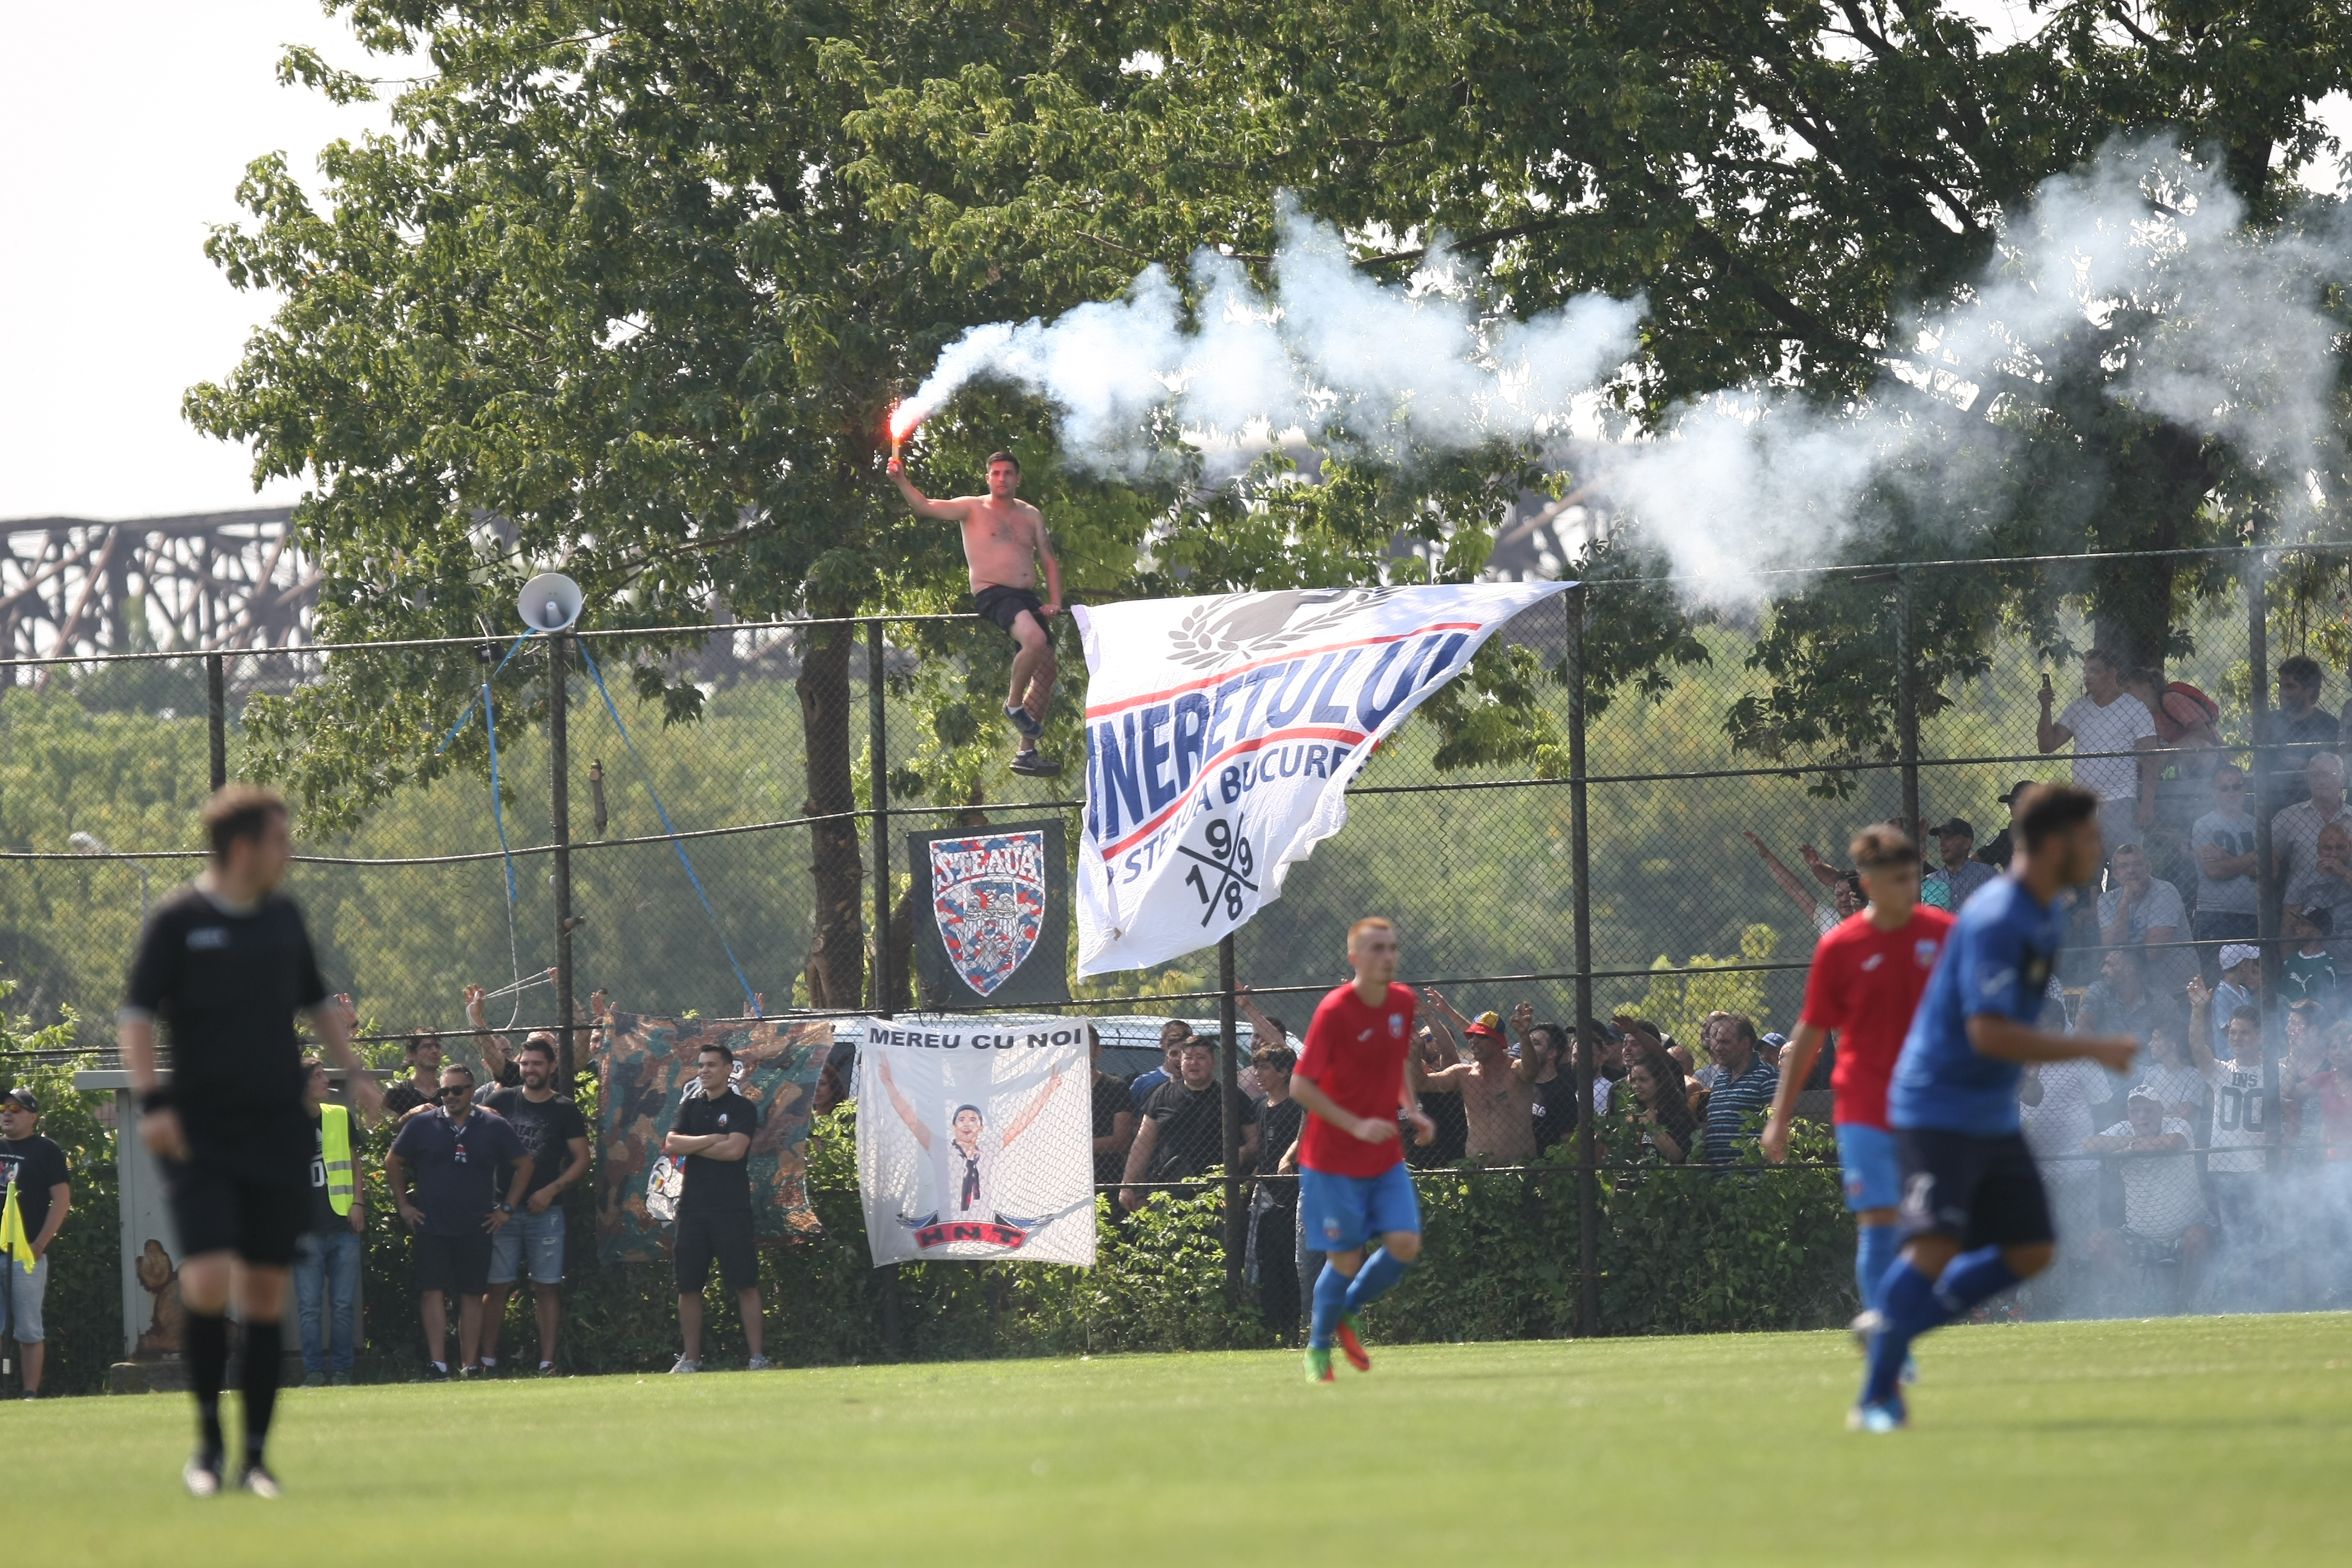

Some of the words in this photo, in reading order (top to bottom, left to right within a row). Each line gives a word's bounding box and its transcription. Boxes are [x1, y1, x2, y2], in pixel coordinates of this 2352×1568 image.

[1123, 781, 1213, 884] STEAUA
[935, 841, 1040, 886] STEAUA
[869, 1027, 961, 1050] MEREU
[971, 1033, 1014, 1050] CU
[1027, 1028, 1082, 1049] NOI
